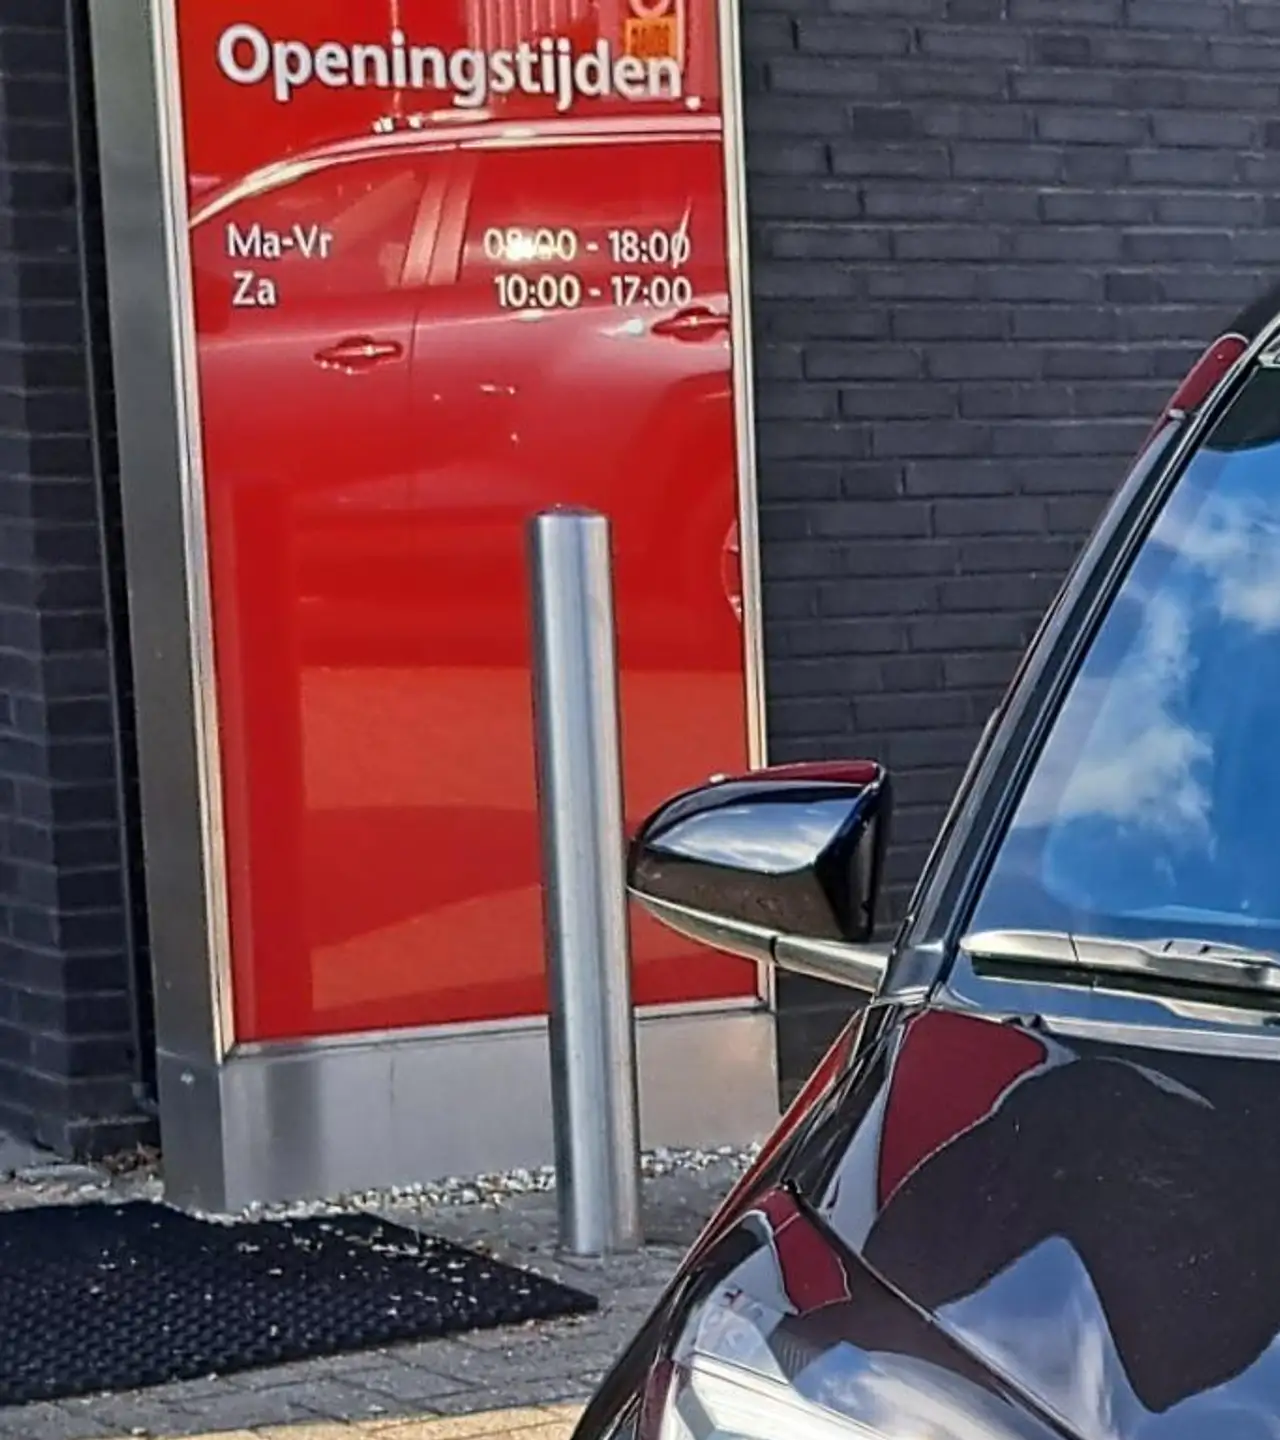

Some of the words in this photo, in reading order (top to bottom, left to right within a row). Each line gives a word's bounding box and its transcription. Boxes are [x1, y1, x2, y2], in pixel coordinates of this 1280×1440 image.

[218, 23, 682, 110] Openingstijden
[227, 221, 333, 259] Ma-Vr
[608, 229, 691, 263] 18:00
[232, 270, 277, 306] Za
[495, 274, 580, 307] 10:00
[611, 276, 692, 306] 17:00
